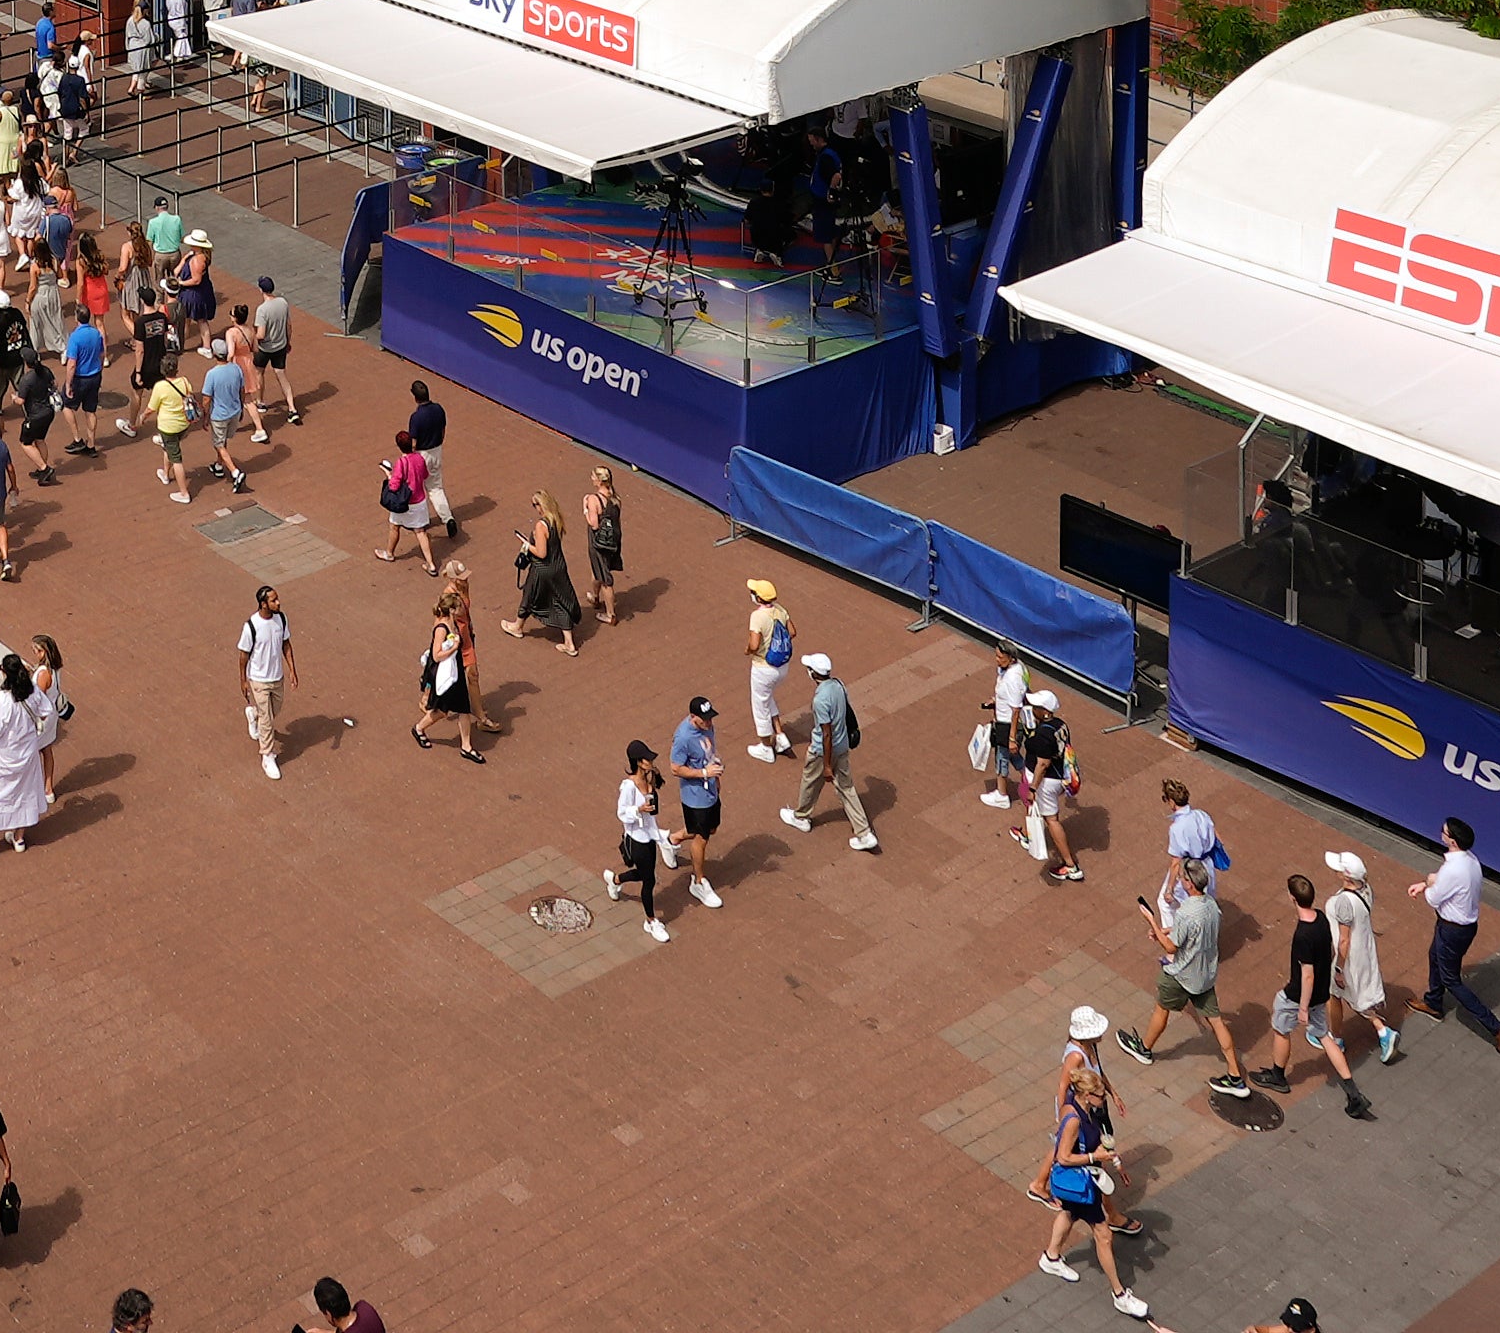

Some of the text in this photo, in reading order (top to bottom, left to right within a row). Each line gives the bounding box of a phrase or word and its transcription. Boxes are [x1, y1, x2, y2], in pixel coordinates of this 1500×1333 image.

[528, 0, 628, 52] sports
[530, 328, 642, 398] us open
